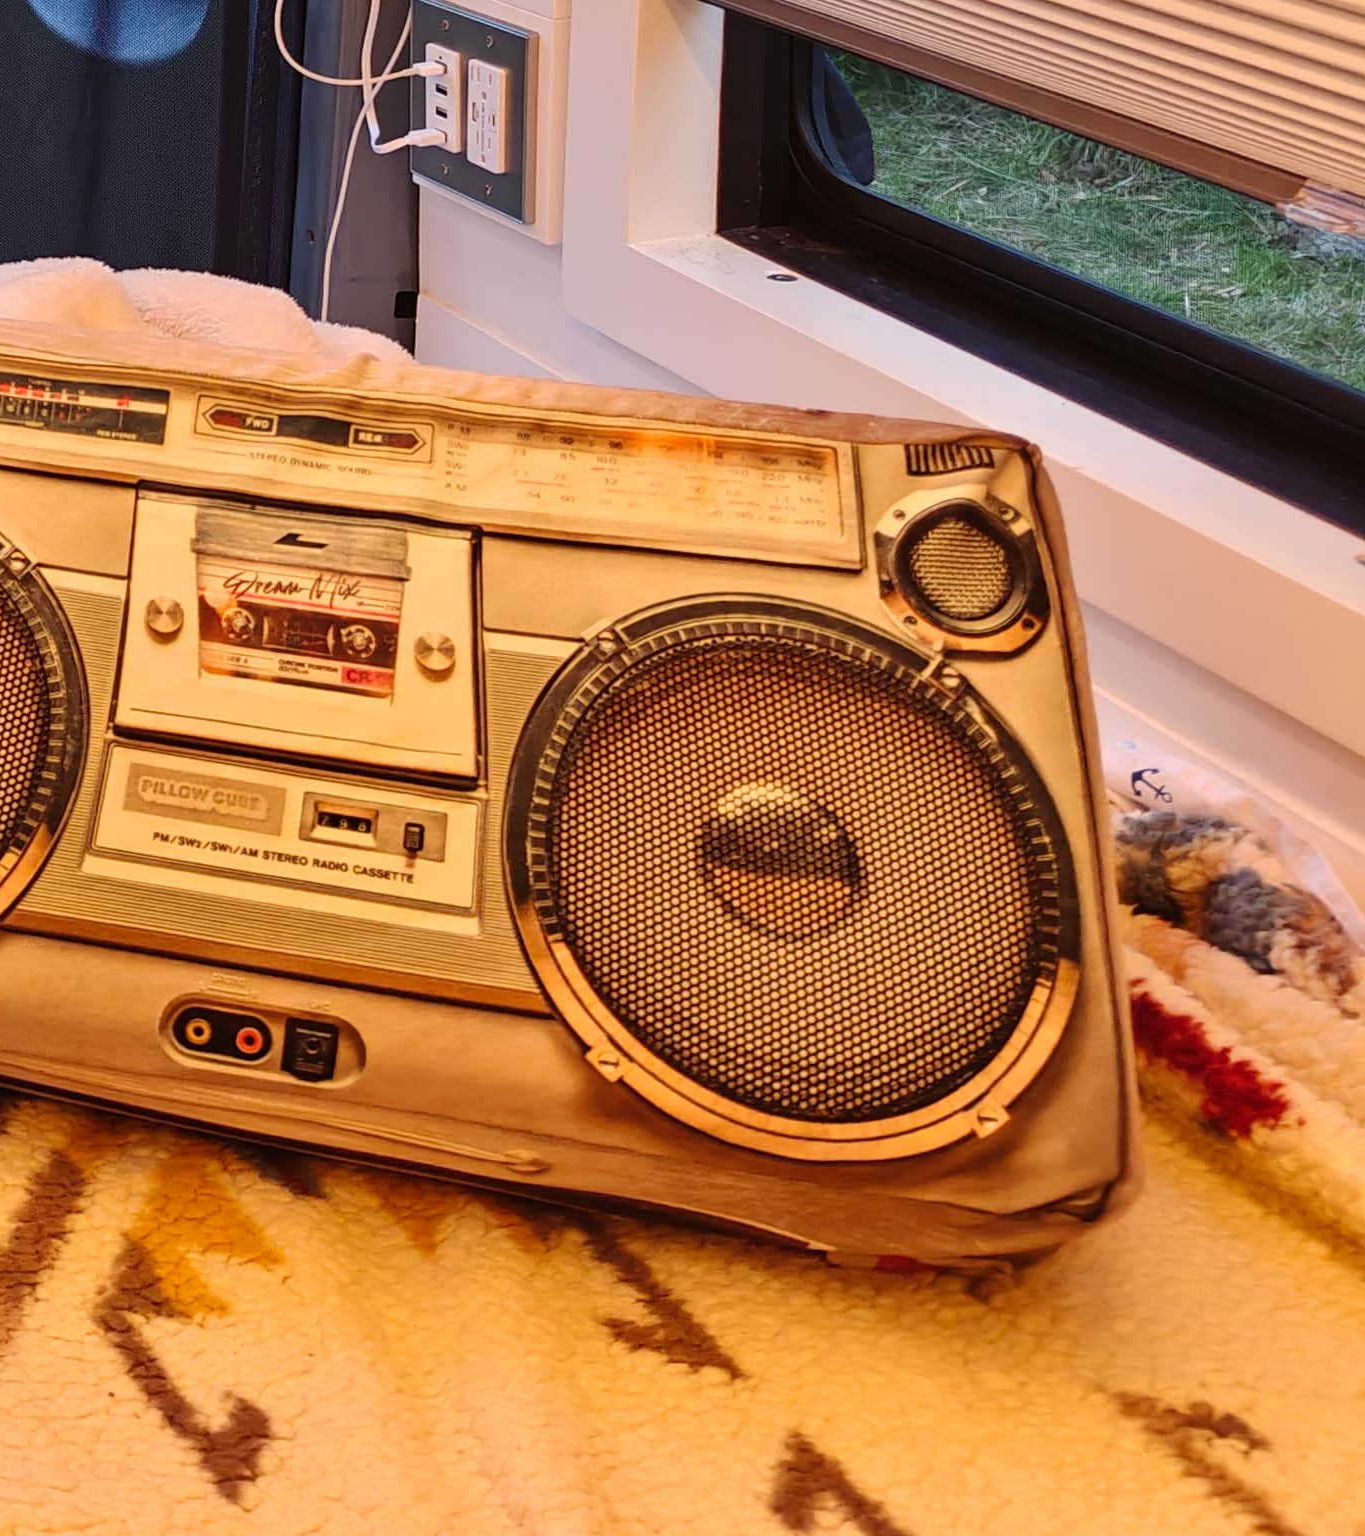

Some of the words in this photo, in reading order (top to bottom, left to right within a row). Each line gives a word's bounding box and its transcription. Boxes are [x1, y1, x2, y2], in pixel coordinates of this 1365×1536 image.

[245, 415, 270, 430] FWD
[248, 451, 287, 465] STEREO
[309, 573, 360, 609] Mix
[140, 778, 209, 802] PILLOW
[212, 790, 262, 811] CUBE
[261, 849, 309, 867] STEREO
[312, 858, 349, 873] RADIO
[352, 865, 415, 884] CASSETTE
